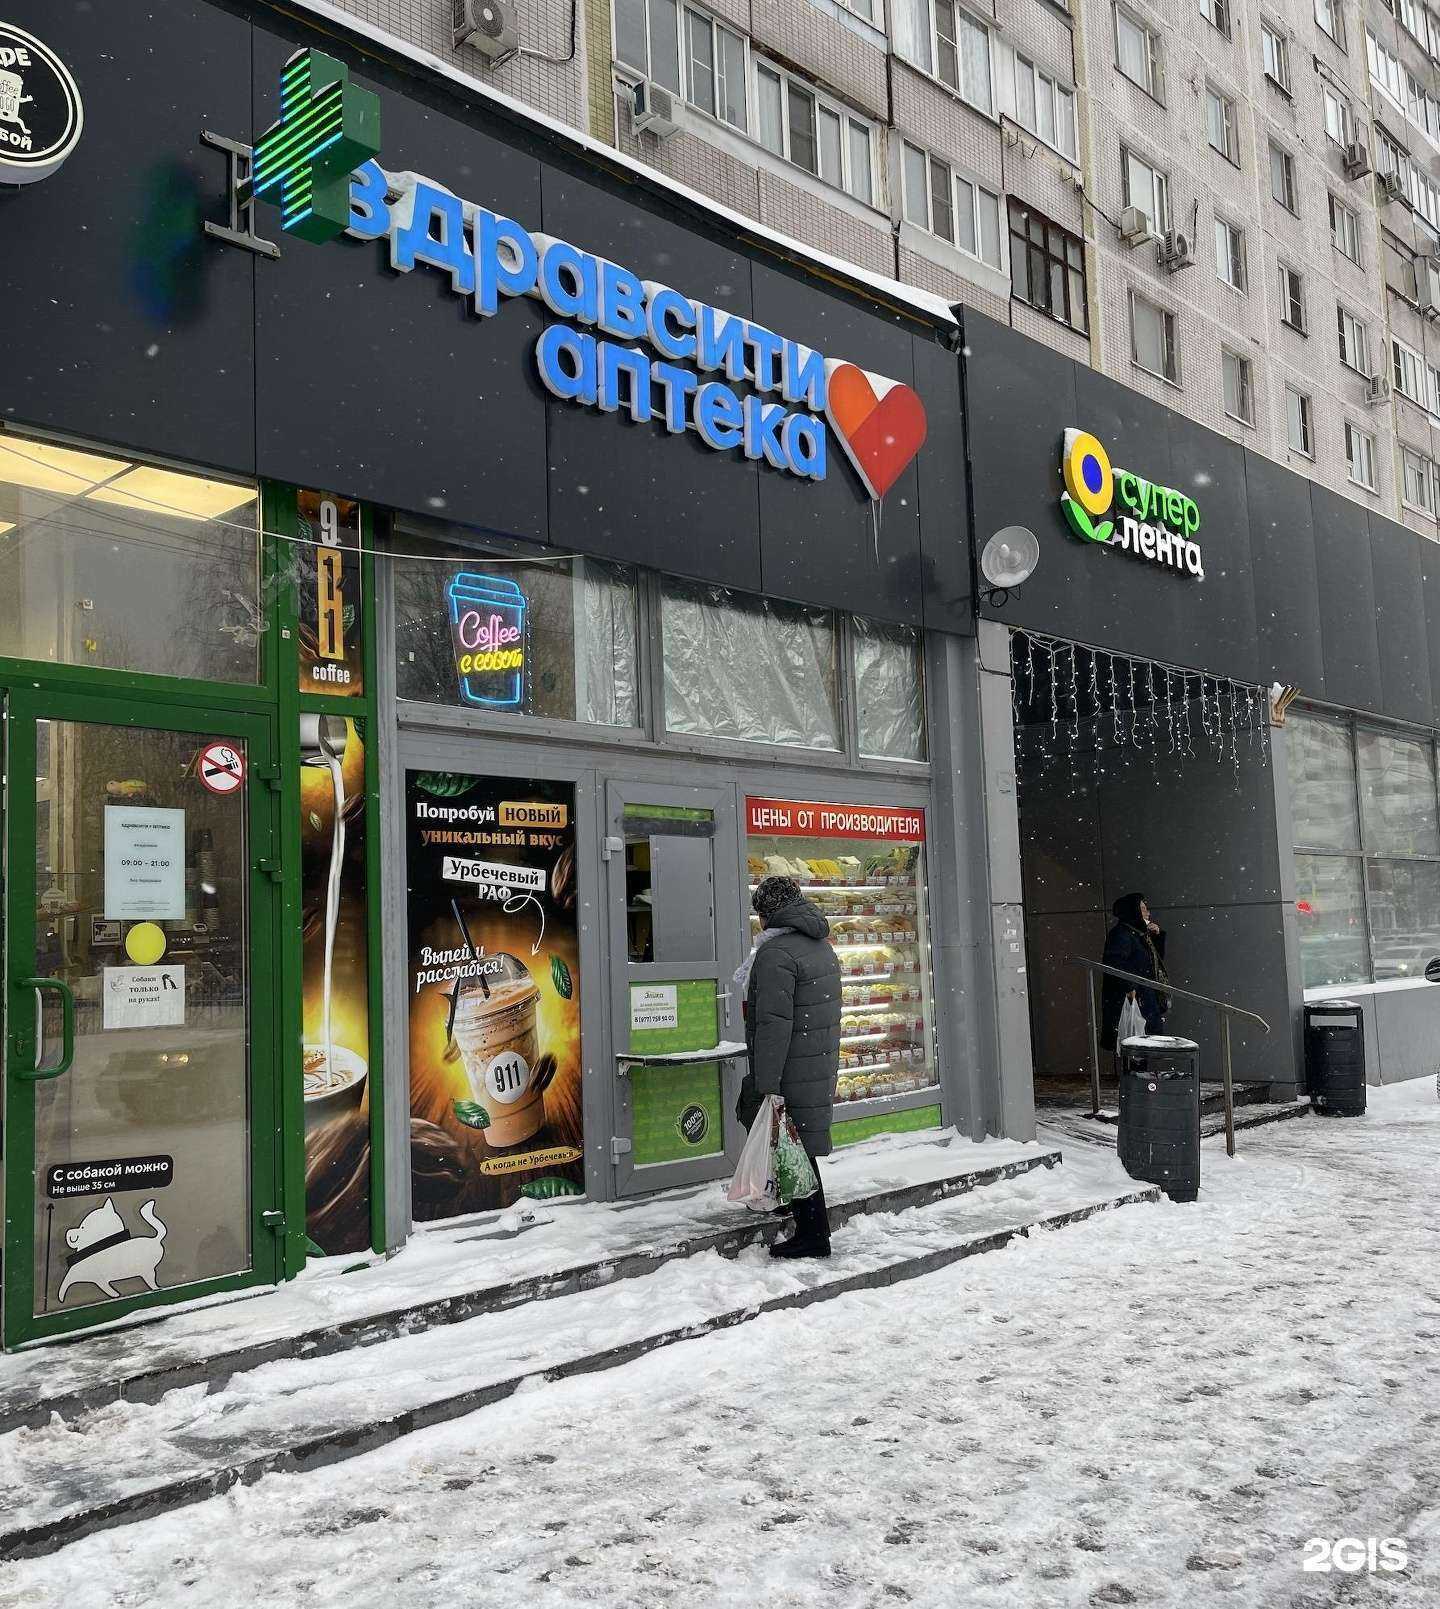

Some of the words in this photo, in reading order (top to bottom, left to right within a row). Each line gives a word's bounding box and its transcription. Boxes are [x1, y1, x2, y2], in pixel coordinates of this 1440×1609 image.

[350, 158, 827, 412] здравсити
[536, 323, 827, 481] аптека
[1118, 472, 1201, 538] супер
[1117, 516, 1205, 577] лента
[460, 610, 521, 652] Coffee
[312, 664, 351, 684] coffee
[416, 802, 496, 824] Попробуй
[505, 806, 561, 824] НОВЫЙ
[752, 808, 792, 830] ЦЕНЫ
[797, 810, 815, 829] ОТ
[821, 812, 921, 835] ПРОИЗВОДИТЕЛЯ
[421, 830, 526, 847] уникальный
[529, 834, 564, 849] вкус
[450, 859, 539, 885] Урбечевый
[478, 884, 512, 901] РАФ
[420, 943, 472, 966] Выпей
[475, 946, 486, 958] и
[416, 954, 505, 993] расслабься!
[493, 1060, 521, 1093] 911
[684, 1110, 703, 1131] 100%
[53, 1169, 64, 1182] С
[66, 1164, 122, 1181] собакой
[125, 1162, 169, 1175] можно
[52, 1185, 65, 1194] Не
[66, 1183, 90, 1193] выше
[92, 1181, 102, 1190] 35
[104, 1181, 116, 1189] см
